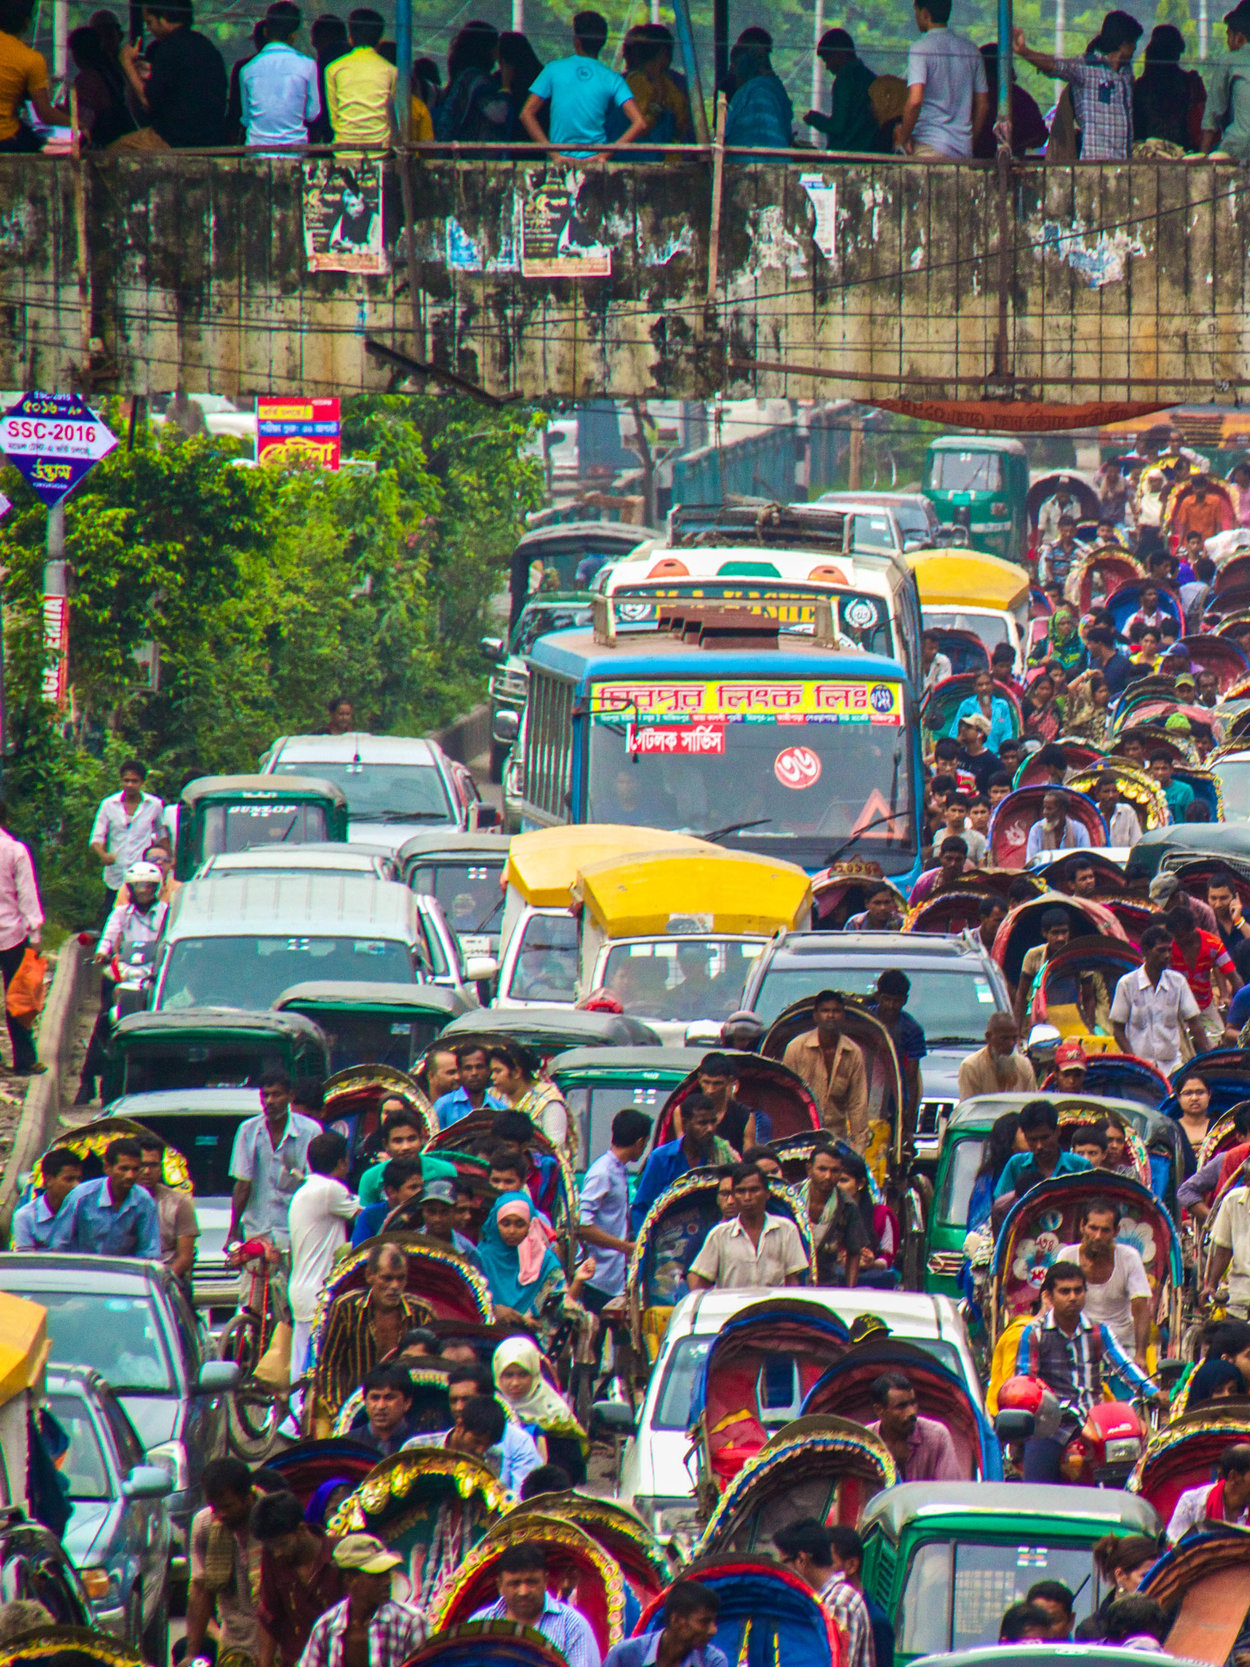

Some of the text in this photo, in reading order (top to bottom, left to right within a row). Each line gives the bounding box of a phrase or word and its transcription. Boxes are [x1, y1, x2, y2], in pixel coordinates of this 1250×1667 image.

[8, 421, 96, 443] SSC-2016
[599, 684, 706, 712] মিরপুর
[716, 683, 804, 708] লিংক
[813, 684, 869, 708] লিঃ
[681, 725, 722, 751] সার্ভিস
[777, 748, 817, 782] ৩৬
